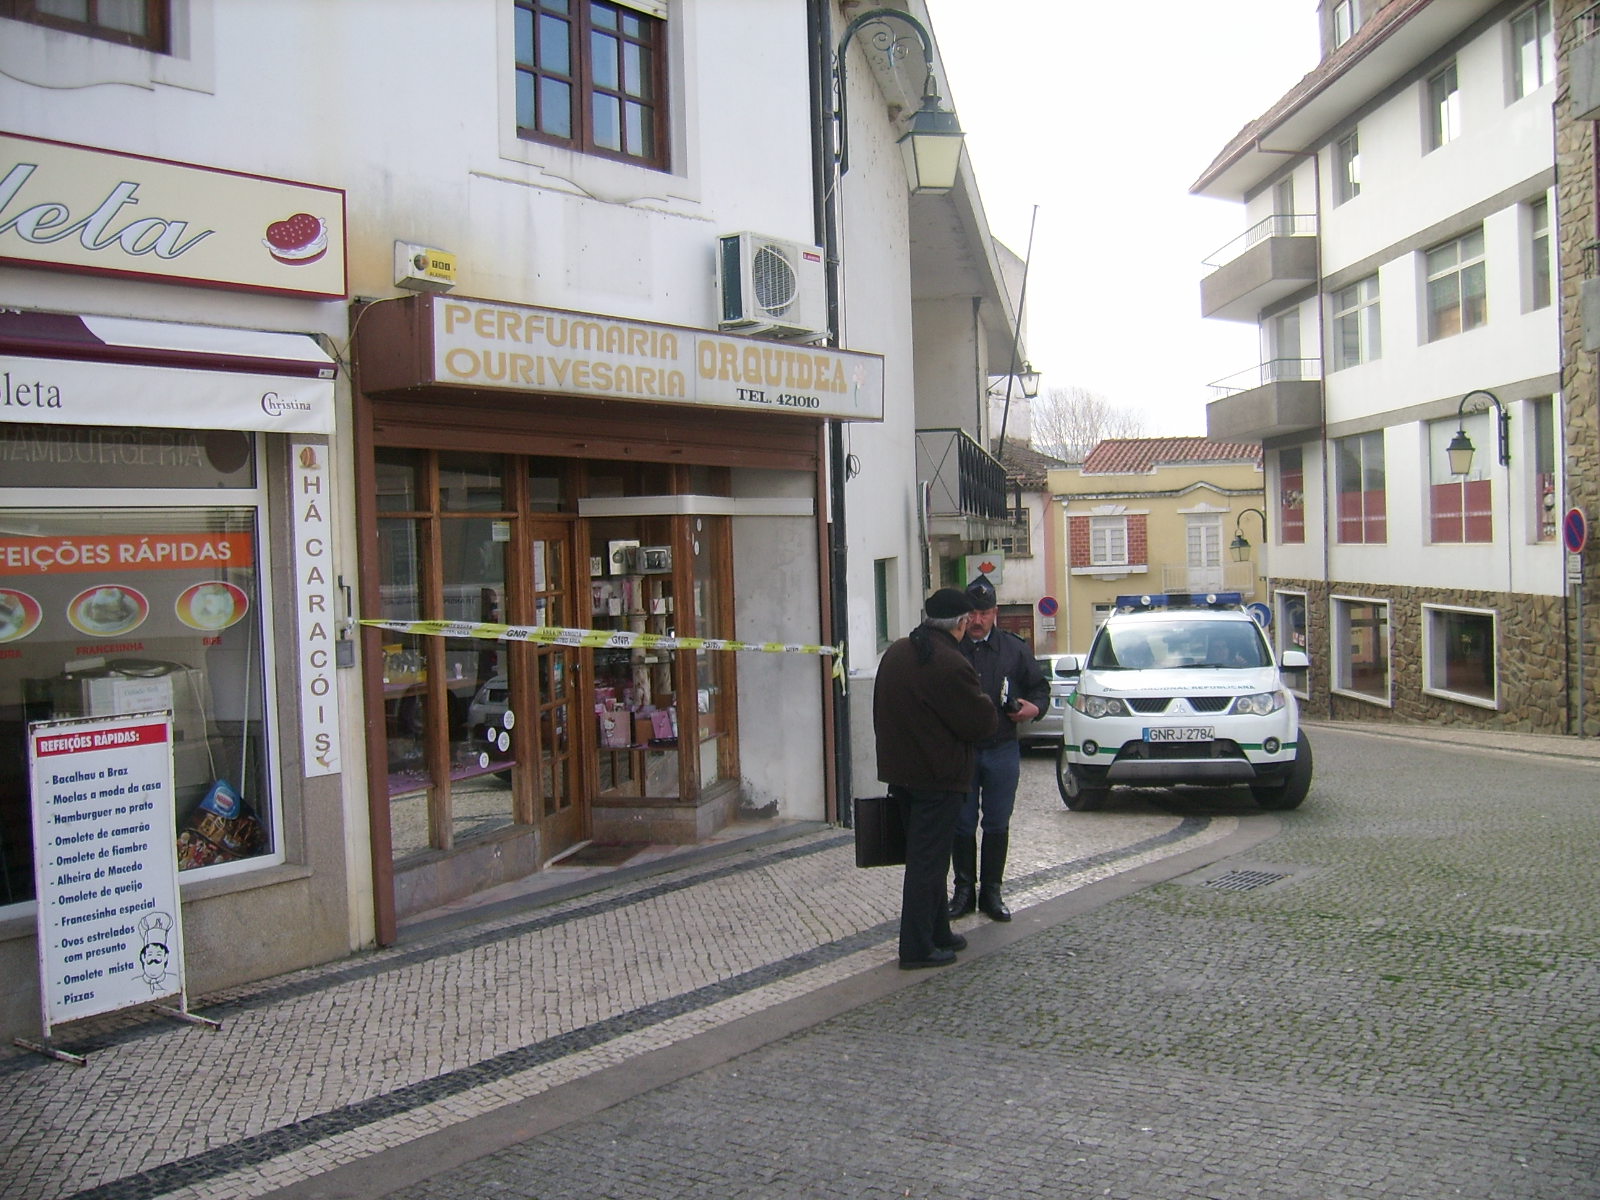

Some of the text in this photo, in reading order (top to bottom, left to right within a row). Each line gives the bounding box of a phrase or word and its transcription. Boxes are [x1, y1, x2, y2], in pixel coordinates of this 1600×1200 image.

[444, 304, 678, 360] PERFUMARIA
[445, 348, 685, 397] OURIVESARIA
[698, 339, 848, 393] ORQUIDEA
[0, 372, 62, 408] leta
[736, 388, 820, 409] TEL. 421010
[261, 391, 312, 417] Christina
[119, 538, 232, 563] RÁPIDAS
[506, 629, 528, 639] GNR
[611, 635, 630, 645] GNR
[41, 731, 140, 753] REFEIÇÕES RÁPIDAS:
[52, 767, 129, 785] Bacalhau a Braz
[53, 782, 161, 805] Moelas a moda da casa
[54, 802, 153, 824] Hamburguer no prato
[55, 823, 150, 846] Omolete de camarão
[56, 843, 148, 866] Omolete de fiambre
[57, 862, 143, 886] Alheira de Macedo
[58, 880, 143, 906] Omolete de queijo
[61, 897, 156, 927] Francesinha especial
[61, 925, 136, 949] Ovos estrelados
[64, 942, 127, 963] com presunto
[63, 962, 134, 985] Omolete mista
[64, 990, 95, 1005] Pizzas
